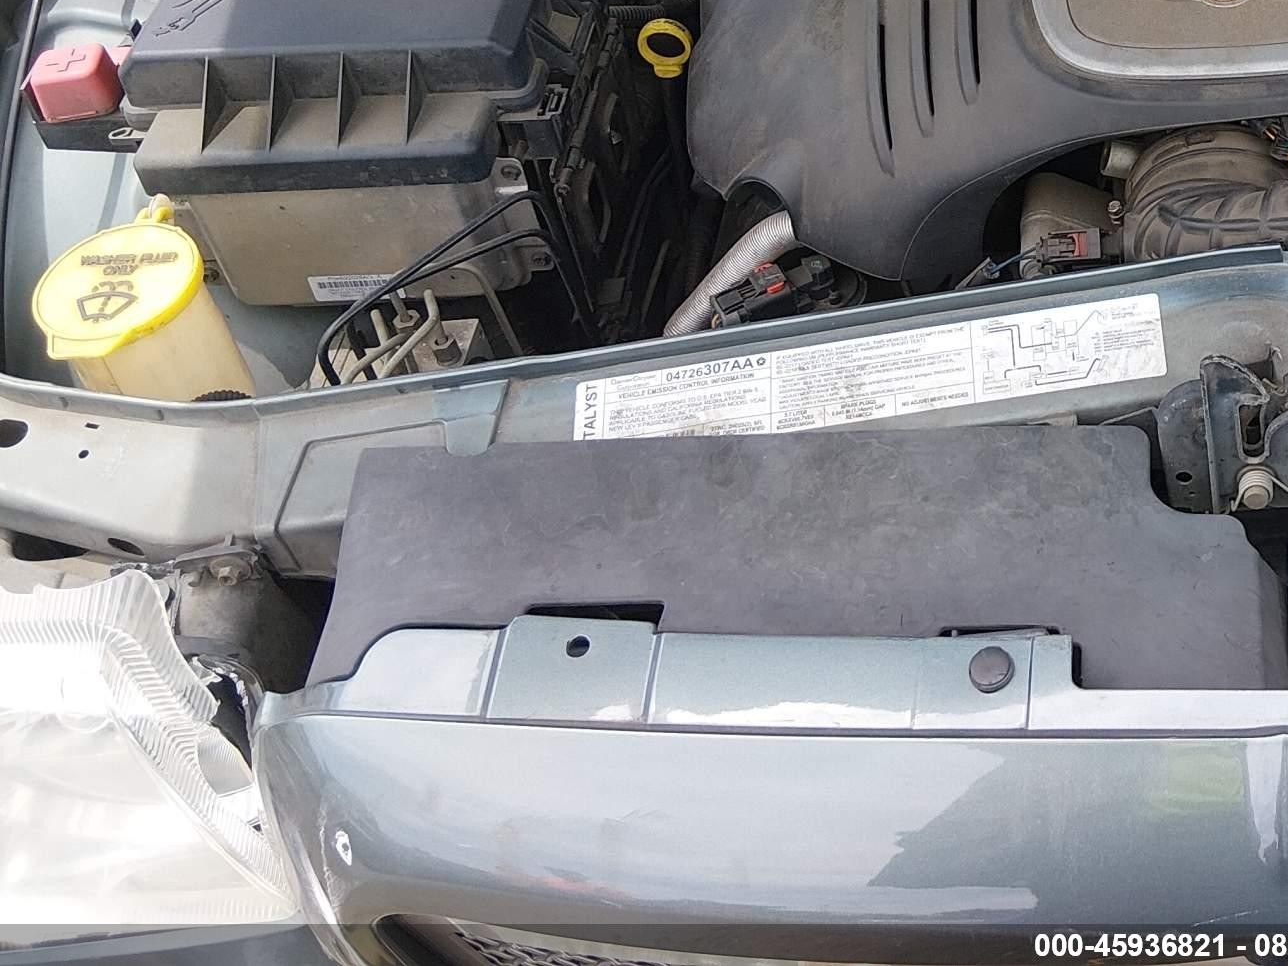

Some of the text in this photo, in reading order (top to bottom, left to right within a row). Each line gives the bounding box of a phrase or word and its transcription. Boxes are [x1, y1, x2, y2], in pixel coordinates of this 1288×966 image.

[80, 252, 178, 266] WASHER FLUID
[103, 265, 139, 275] ONLY
[666, 357, 754, 382] 04726307AA
